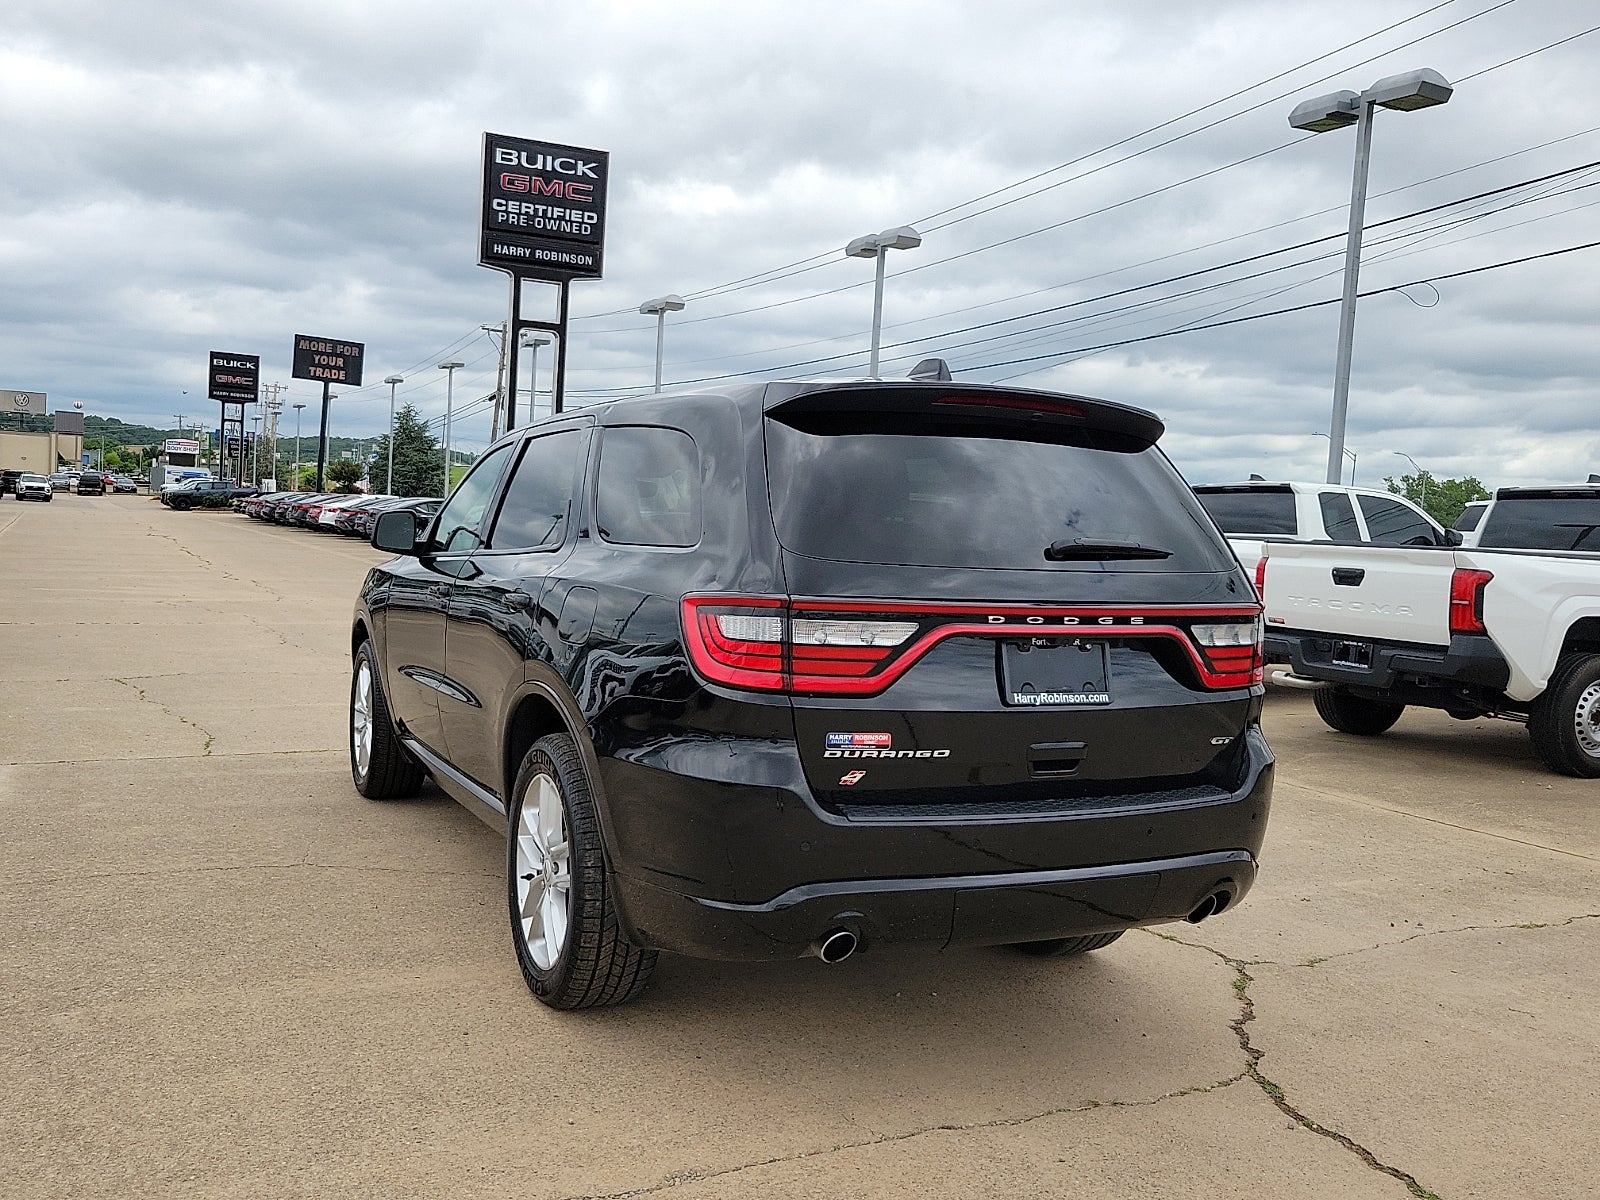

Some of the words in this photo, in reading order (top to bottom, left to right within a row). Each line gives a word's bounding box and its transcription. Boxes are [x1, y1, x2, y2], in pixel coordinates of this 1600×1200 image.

[495, 147, 599, 179] BUICK
[500, 172, 594, 202] GMC
[492, 198, 598, 224] CERTIFIED
[498, 212, 591, 235] PRE-OWNED
[493, 243, 531, 258] HARRY
[535, 250, 593, 266] ROBINSON
[299, 339, 333, 353] MORE
[336, 344, 360, 357] FOR
[213, 358, 256, 370] BUICK
[313, 354, 344, 367] YOUR
[215, 374, 254, 385] GMC
[308, 366, 346, 380] TRADE
[1288, 595, 1414, 617] TACOMA
[988, 615, 1144, 625] DODGE
[1031, 637, 1046, 646] Fort
[1014, 693, 1109, 706] HarryRobinson.com
[1209, 736, 1235, 745] GT
[823, 749, 950, 758] DURANGO
